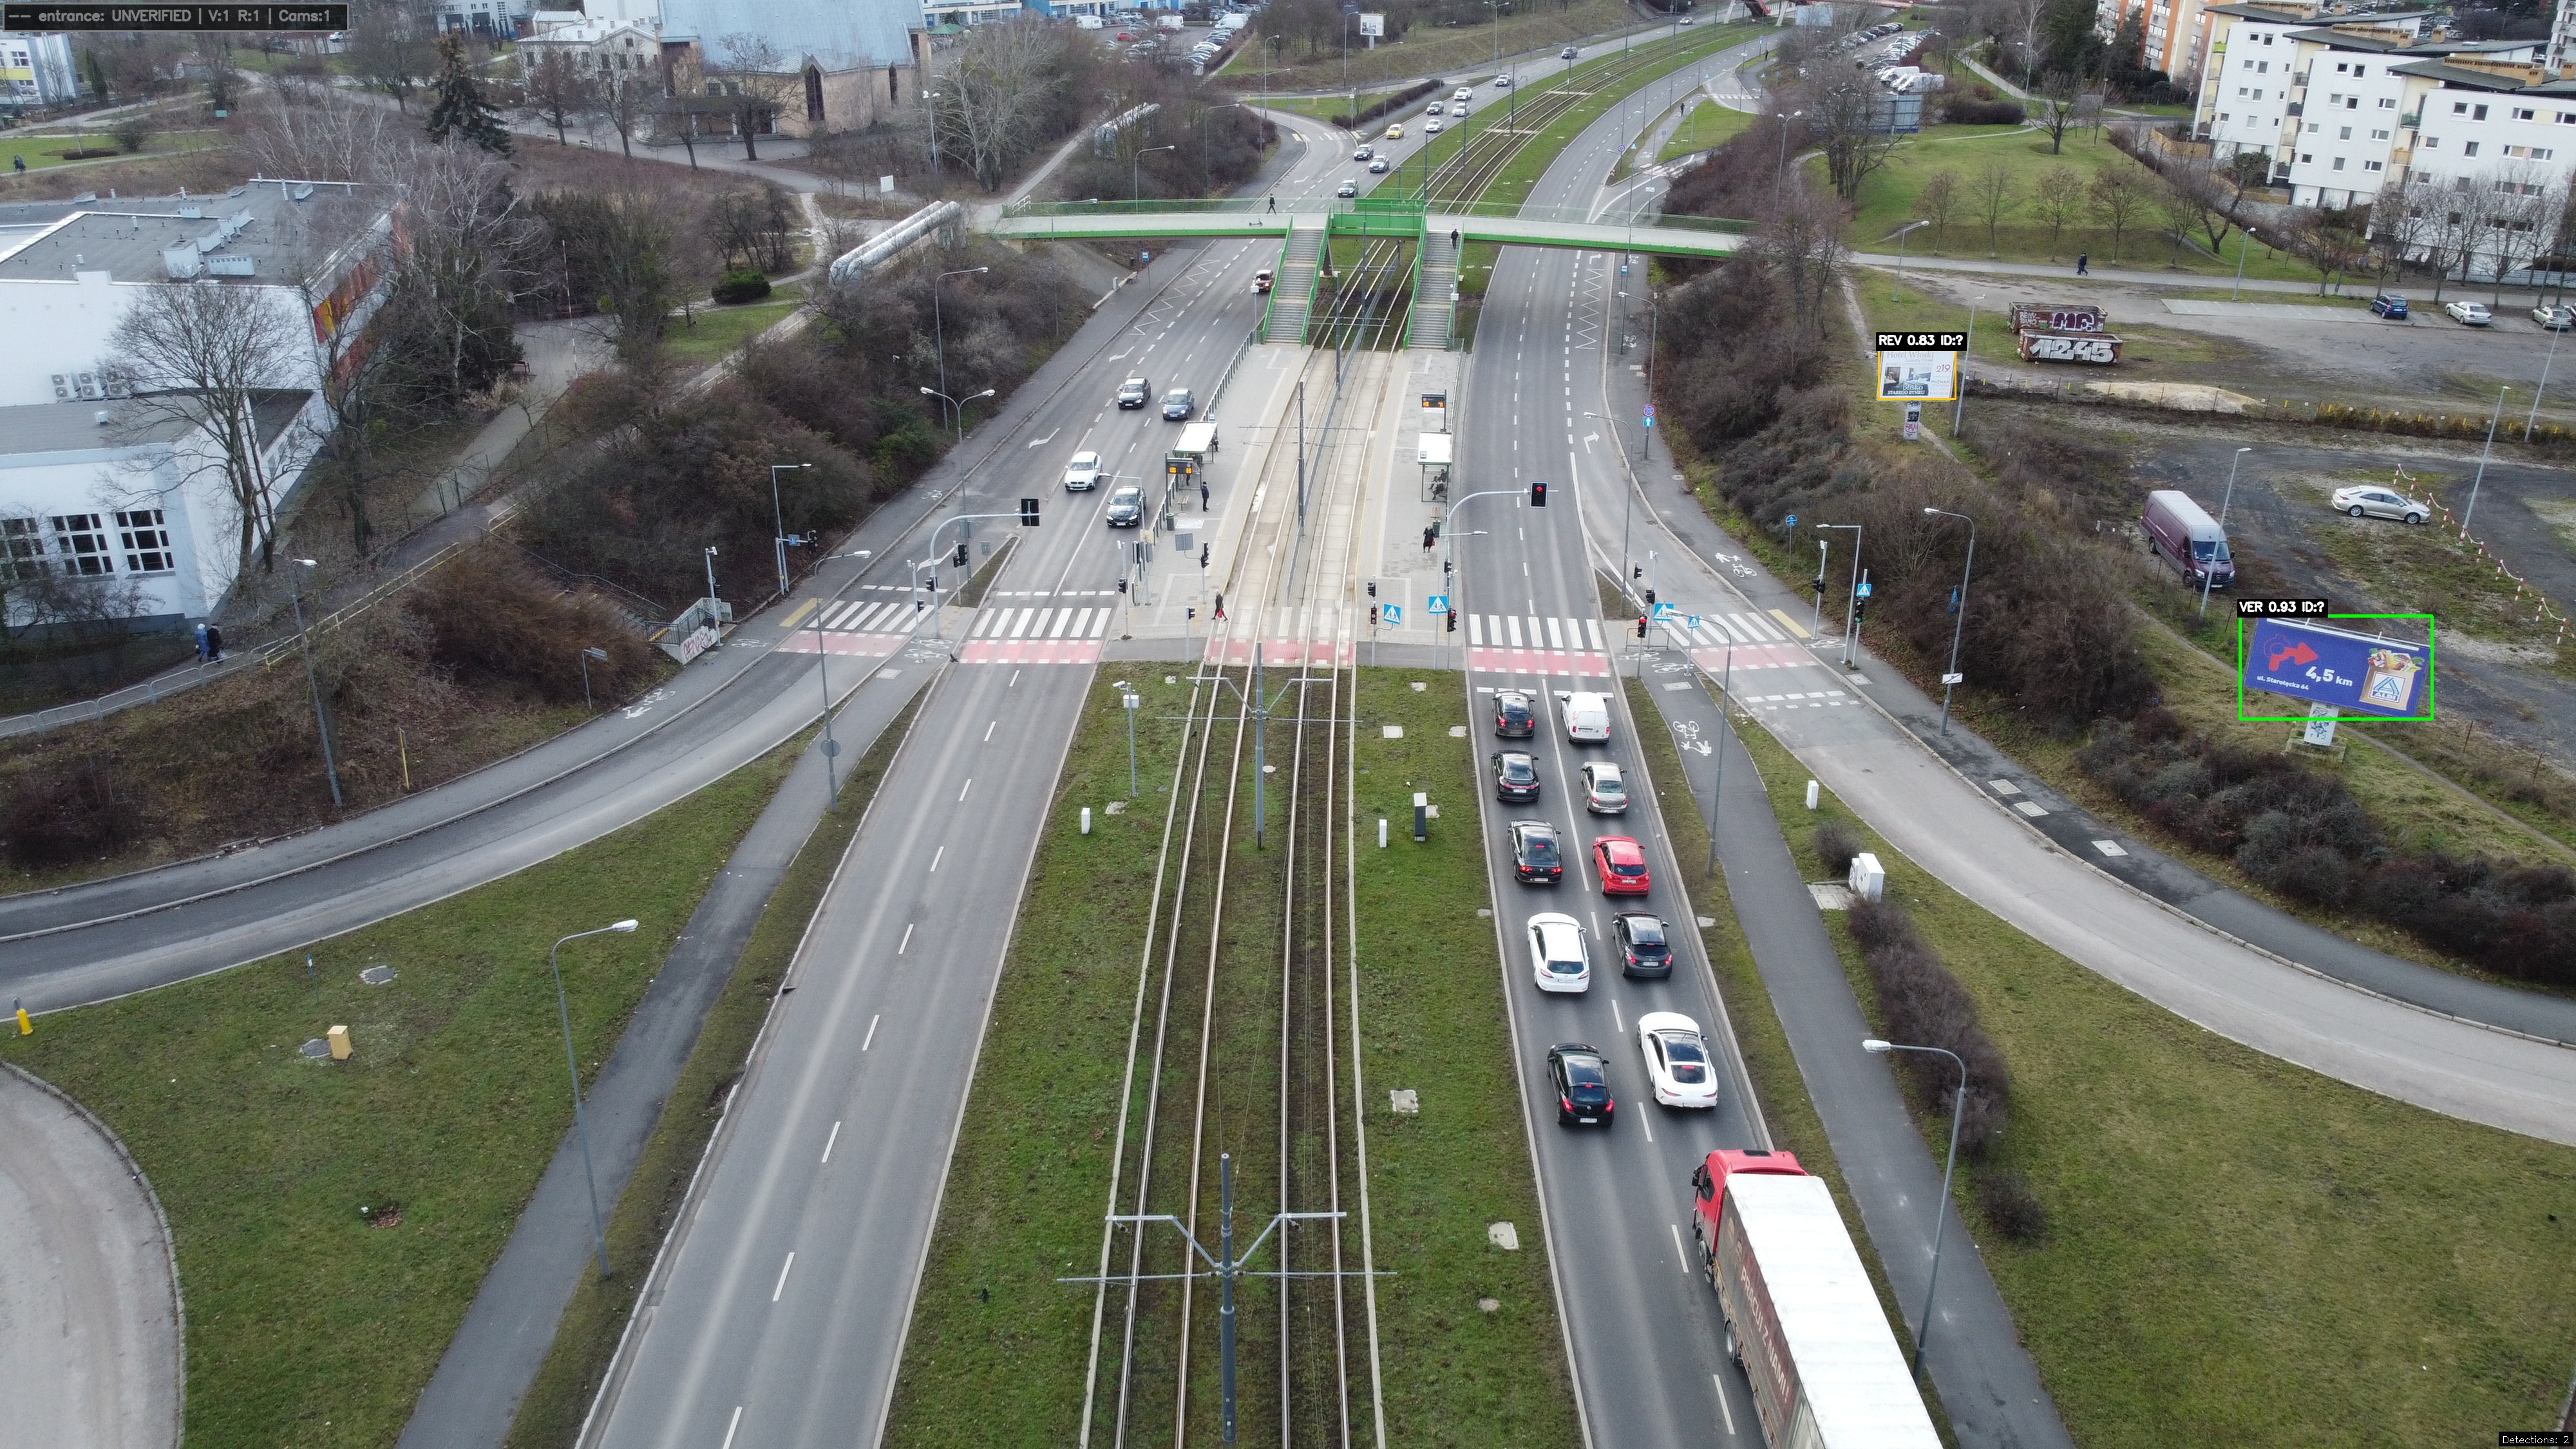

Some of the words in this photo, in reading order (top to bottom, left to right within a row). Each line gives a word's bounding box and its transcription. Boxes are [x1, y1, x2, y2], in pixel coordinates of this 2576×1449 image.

[2029, 339, 2115, 363] 1245
[2306, 665, 2335, 683] 4,5
[2335, 676, 2353, 687] km
[2374, 692, 2397, 701] ALDI
[1761, 1325, 1769, 1347] Z
[1766, 1339, 1790, 1403] NAMI!
